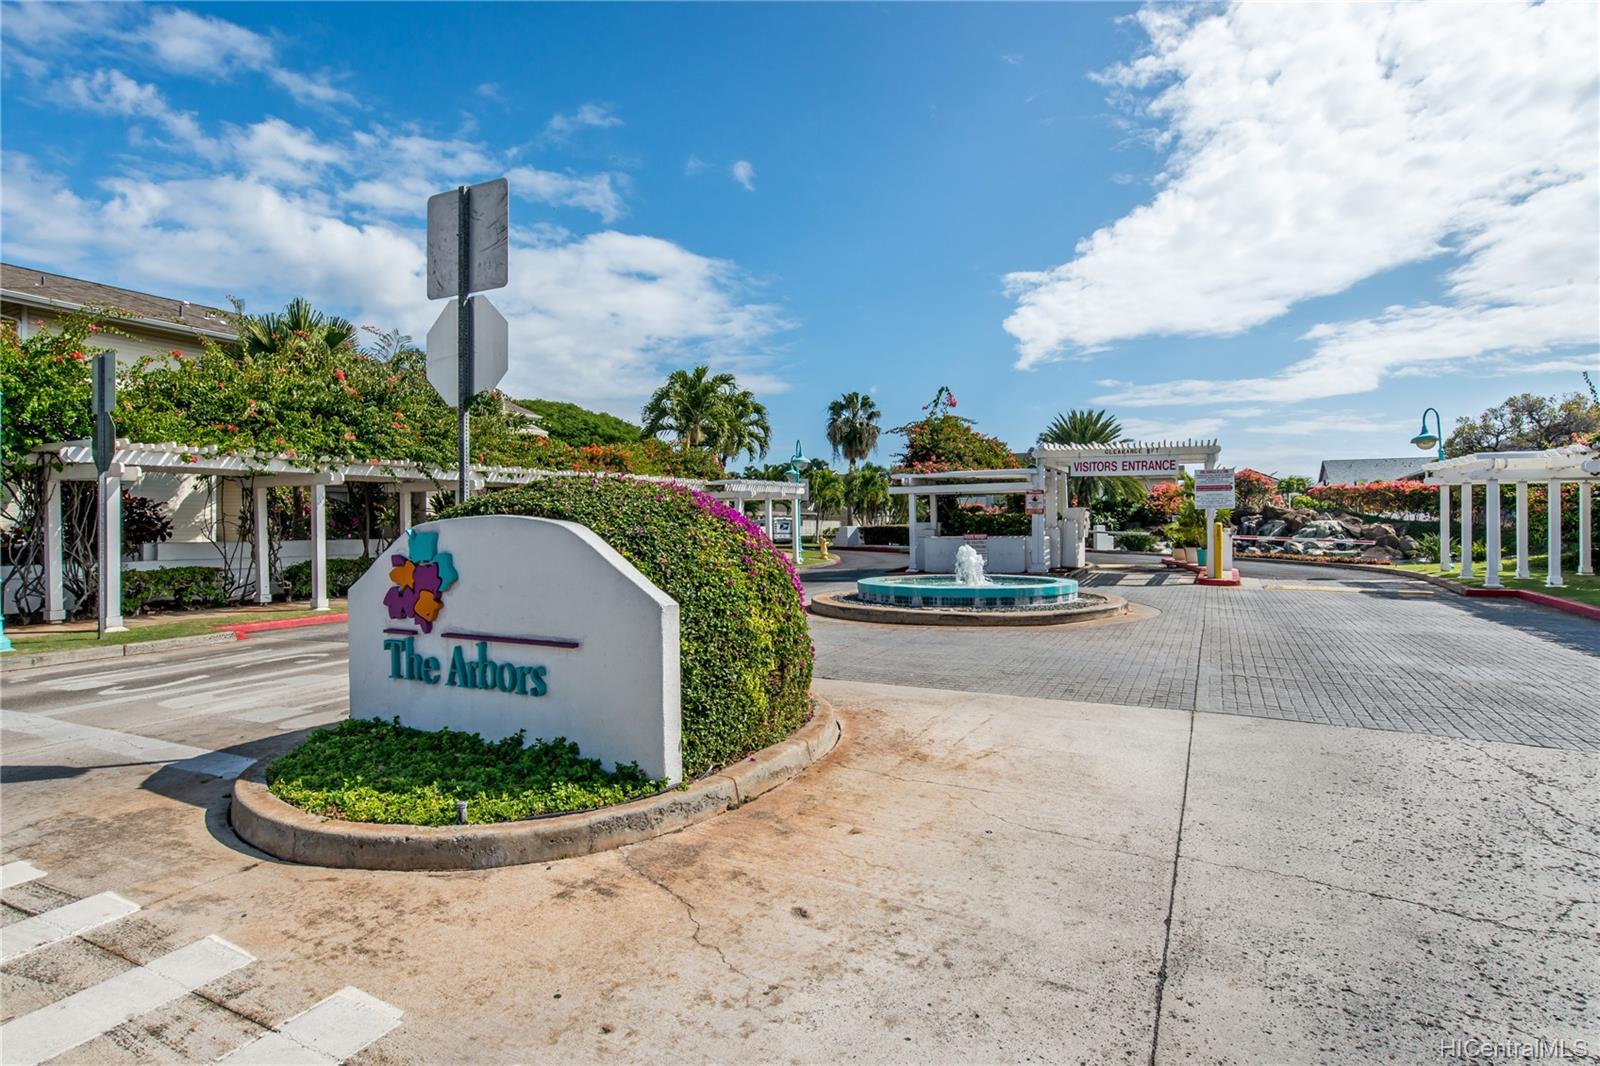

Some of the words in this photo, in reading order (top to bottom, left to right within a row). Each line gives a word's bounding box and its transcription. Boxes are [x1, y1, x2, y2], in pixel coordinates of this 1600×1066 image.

[1073, 461, 1118, 472] VISITORS
[1121, 459, 1177, 471] ENTRANCE
[383, 636, 441, 685] The
[445, 640, 548, 698] Arbors
